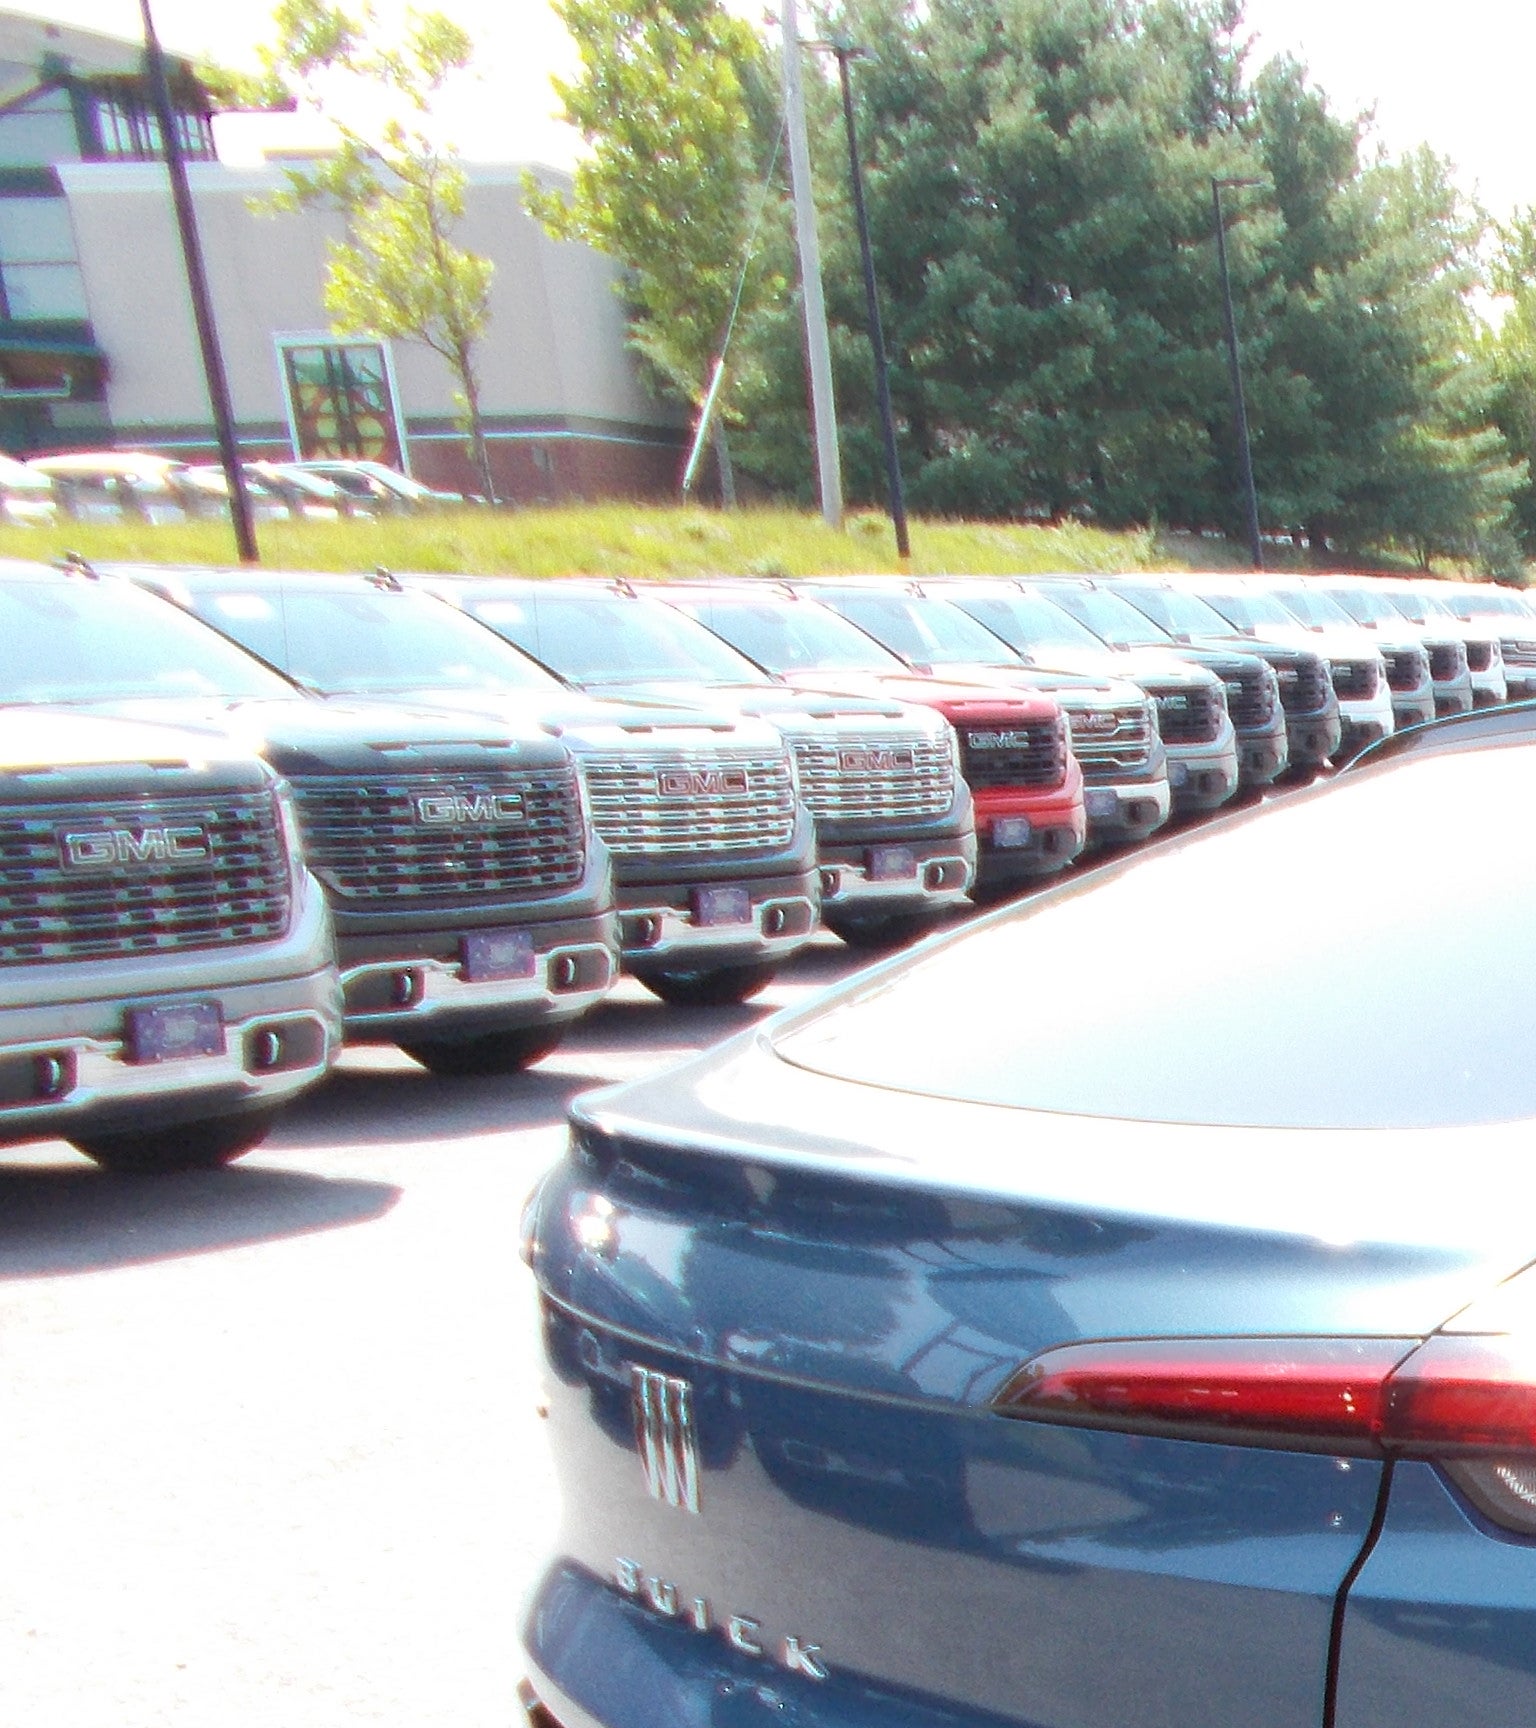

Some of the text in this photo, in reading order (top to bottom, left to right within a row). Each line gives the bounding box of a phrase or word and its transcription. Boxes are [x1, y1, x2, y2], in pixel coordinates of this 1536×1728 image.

[969, 731, 1029, 749] GMC
[841, 751, 912, 770] GMC
[660, 772, 747, 794] GMC
[419, 792, 526, 823] GMC
[65, 825, 208, 865] GMC
[613, 1556, 829, 1680] BUICK
